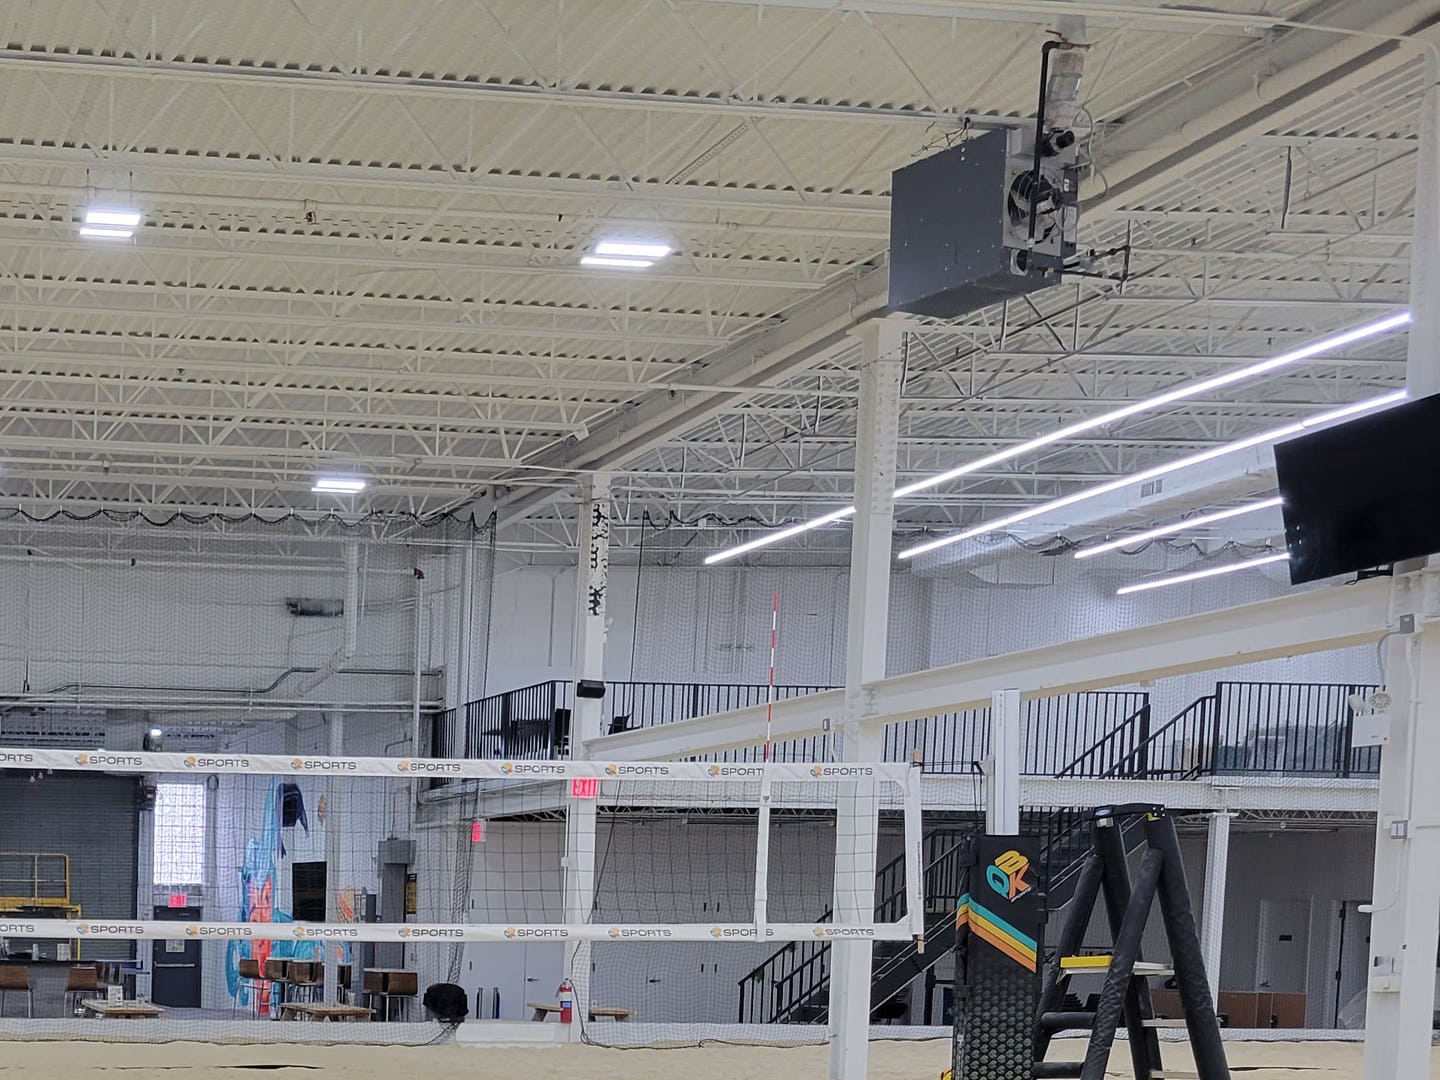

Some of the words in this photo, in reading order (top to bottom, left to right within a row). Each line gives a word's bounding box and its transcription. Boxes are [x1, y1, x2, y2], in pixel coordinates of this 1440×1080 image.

[89, 755, 143, 767] SPORTS
[197, 758, 250, 768] SPORTS
[304, 760, 357, 770] SPORTS
[410, 762, 461, 772] SPORTS
[514, 764, 565, 774] SPORTS
[617, 766, 670, 776] SPORTS
[720, 766, 763, 777] SPORT
[823, 766, 873, 777] SPORTS
[572, 778, 598, 797] EXIT
[90, 924, 145, 935] SPORTS
[199, 926, 253, 936] SPORTS
[305, 928, 359, 938] SPORTS
[411, 928, 464, 938] SPORTS
[516, 927, 569, 938] SPORTS
[620, 928, 672, 938] SPORTS
[722, 928, 775, 937] SPORS
[825, 927, 875, 937] SPORTS
